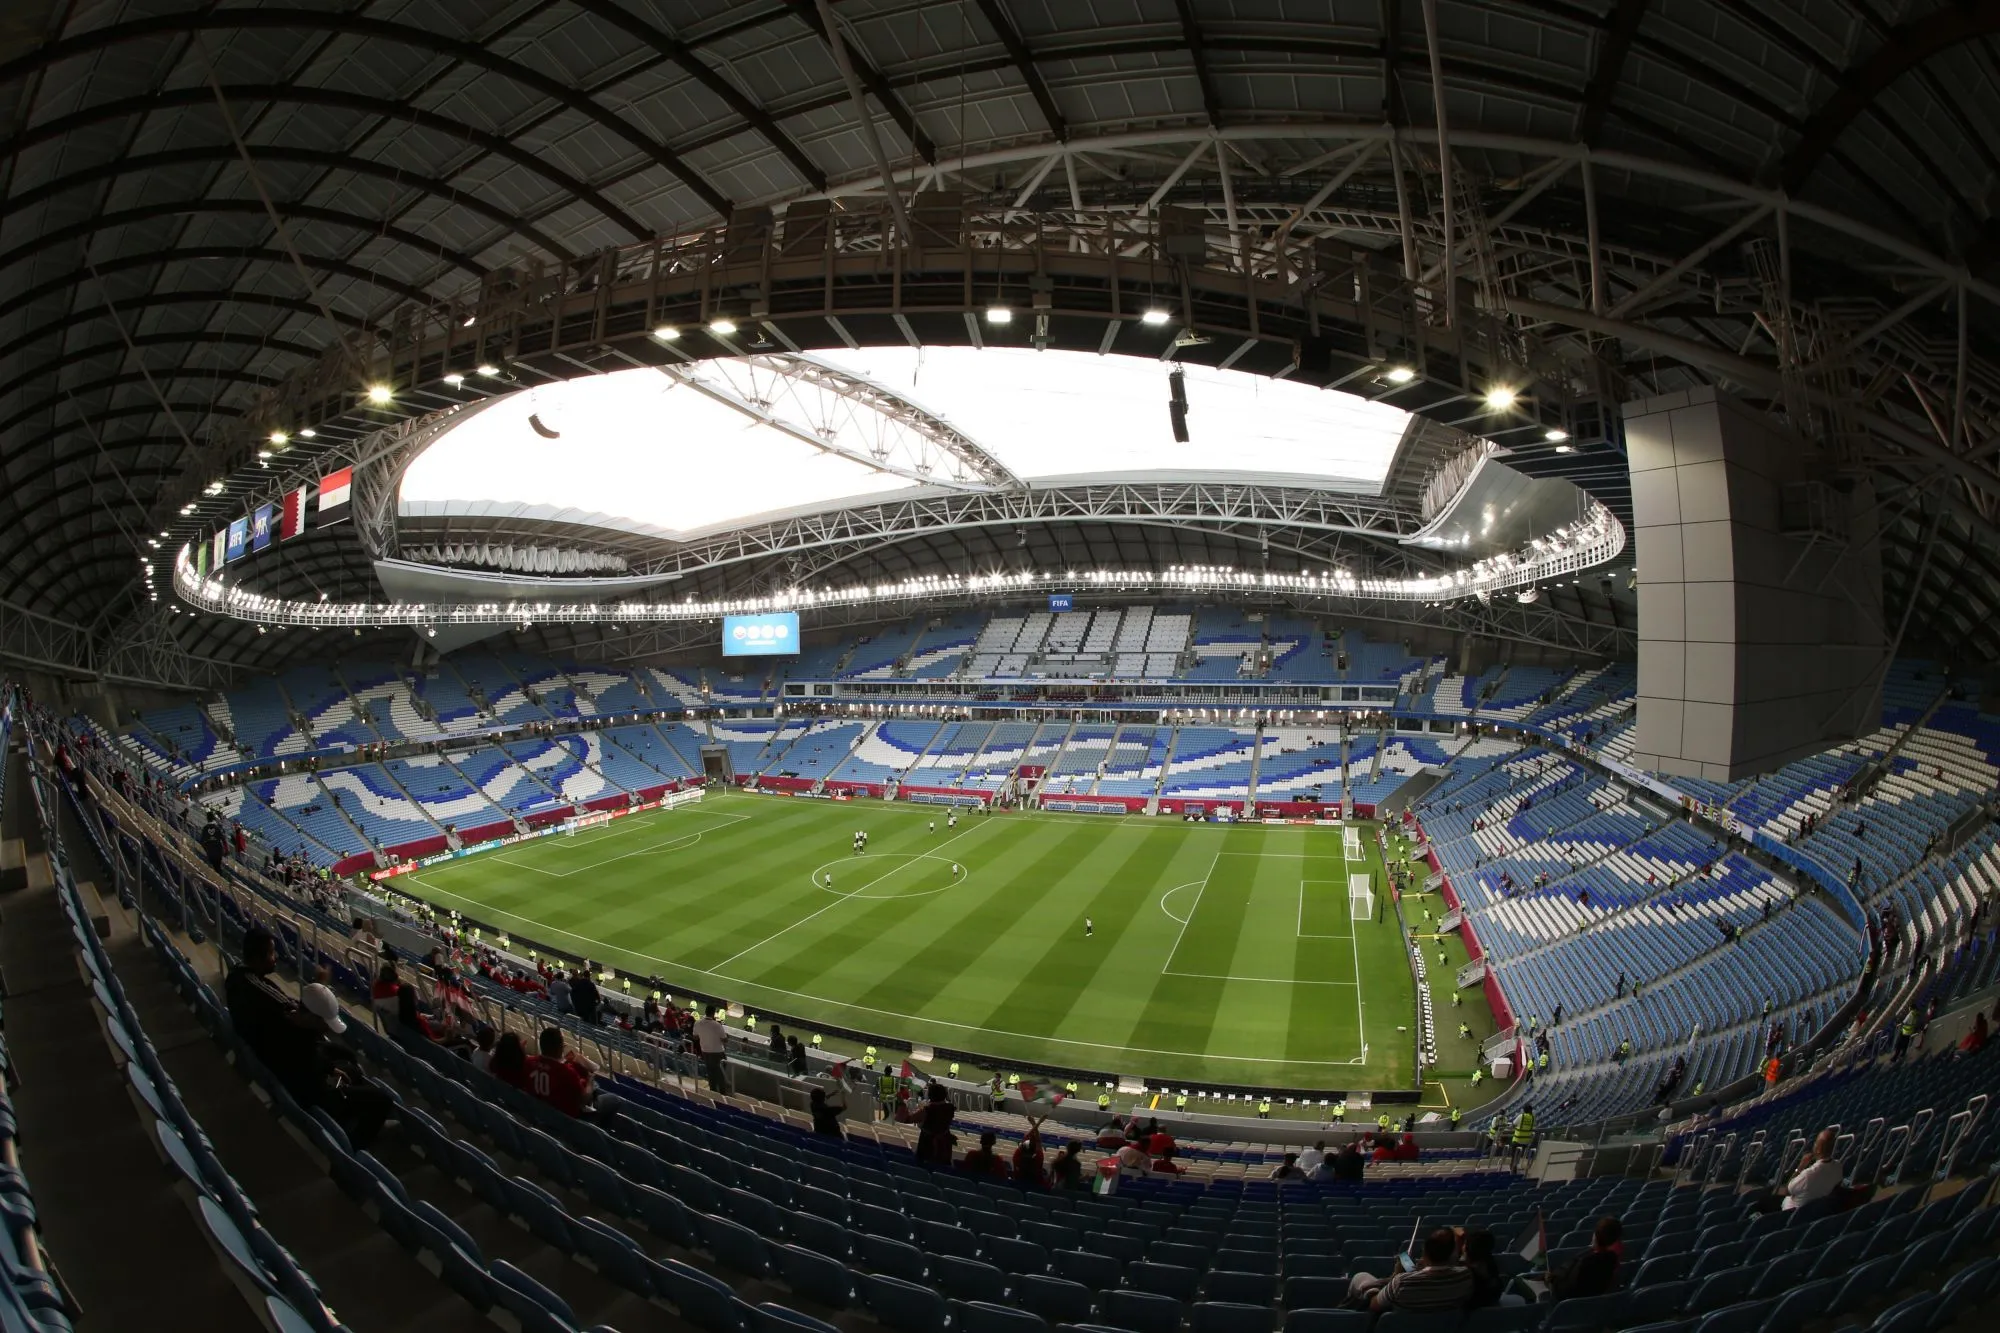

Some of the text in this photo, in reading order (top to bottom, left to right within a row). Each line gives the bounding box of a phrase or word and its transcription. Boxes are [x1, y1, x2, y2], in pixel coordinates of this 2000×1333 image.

[501, 831, 541, 846] QATAR AIRWAYS
[529, 1070, 550, 1097] 10
